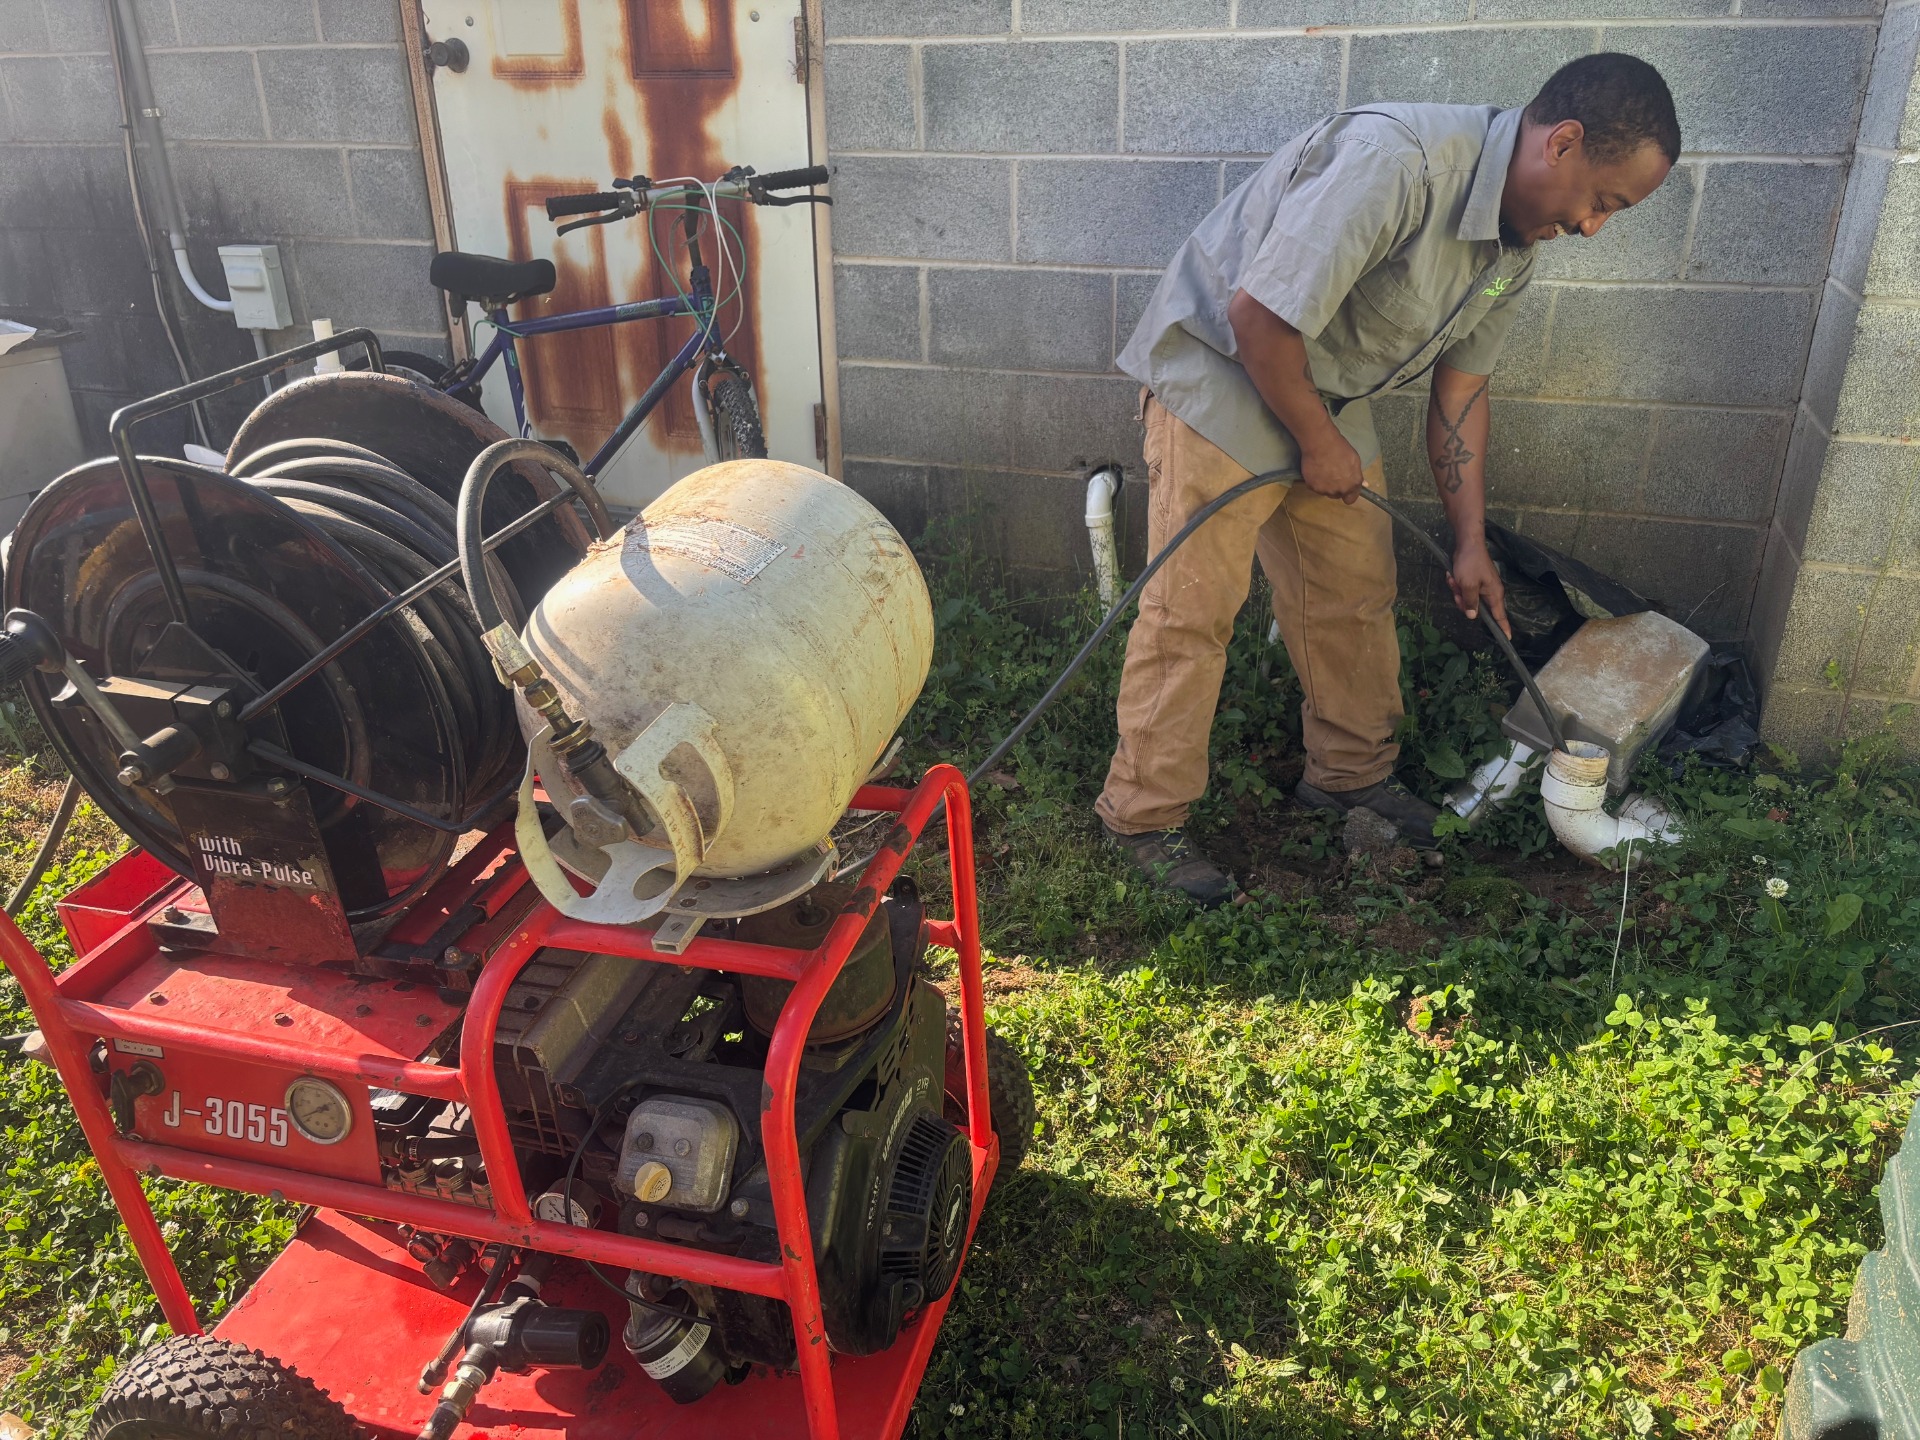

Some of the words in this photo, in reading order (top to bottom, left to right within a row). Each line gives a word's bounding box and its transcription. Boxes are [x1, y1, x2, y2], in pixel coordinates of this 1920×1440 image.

[199, 836, 242, 856] with
[202, 853, 313, 885] Vibra-Pulse
[163, 1090, 288, 1148] J-3055
